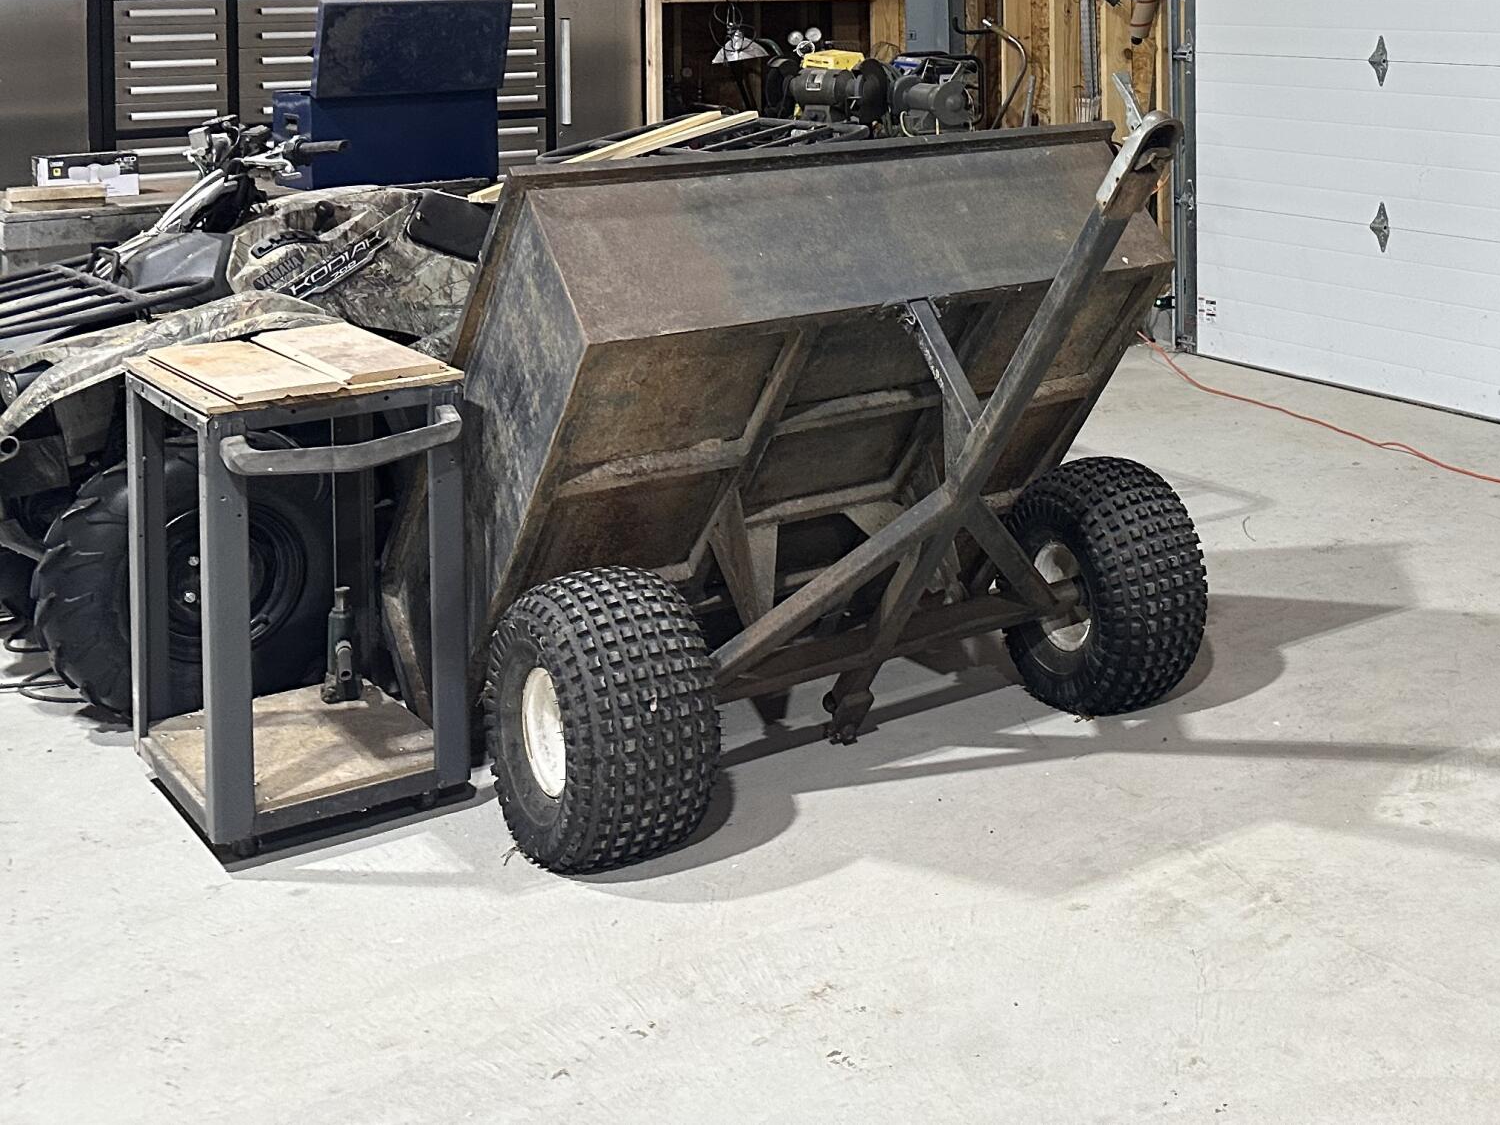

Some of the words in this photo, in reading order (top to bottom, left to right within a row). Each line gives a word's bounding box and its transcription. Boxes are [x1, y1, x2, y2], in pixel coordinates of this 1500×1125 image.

[256, 255, 303, 289] YAMAHA
[289, 230, 383, 296] KODIAK
[330, 262, 358, 279] 700
